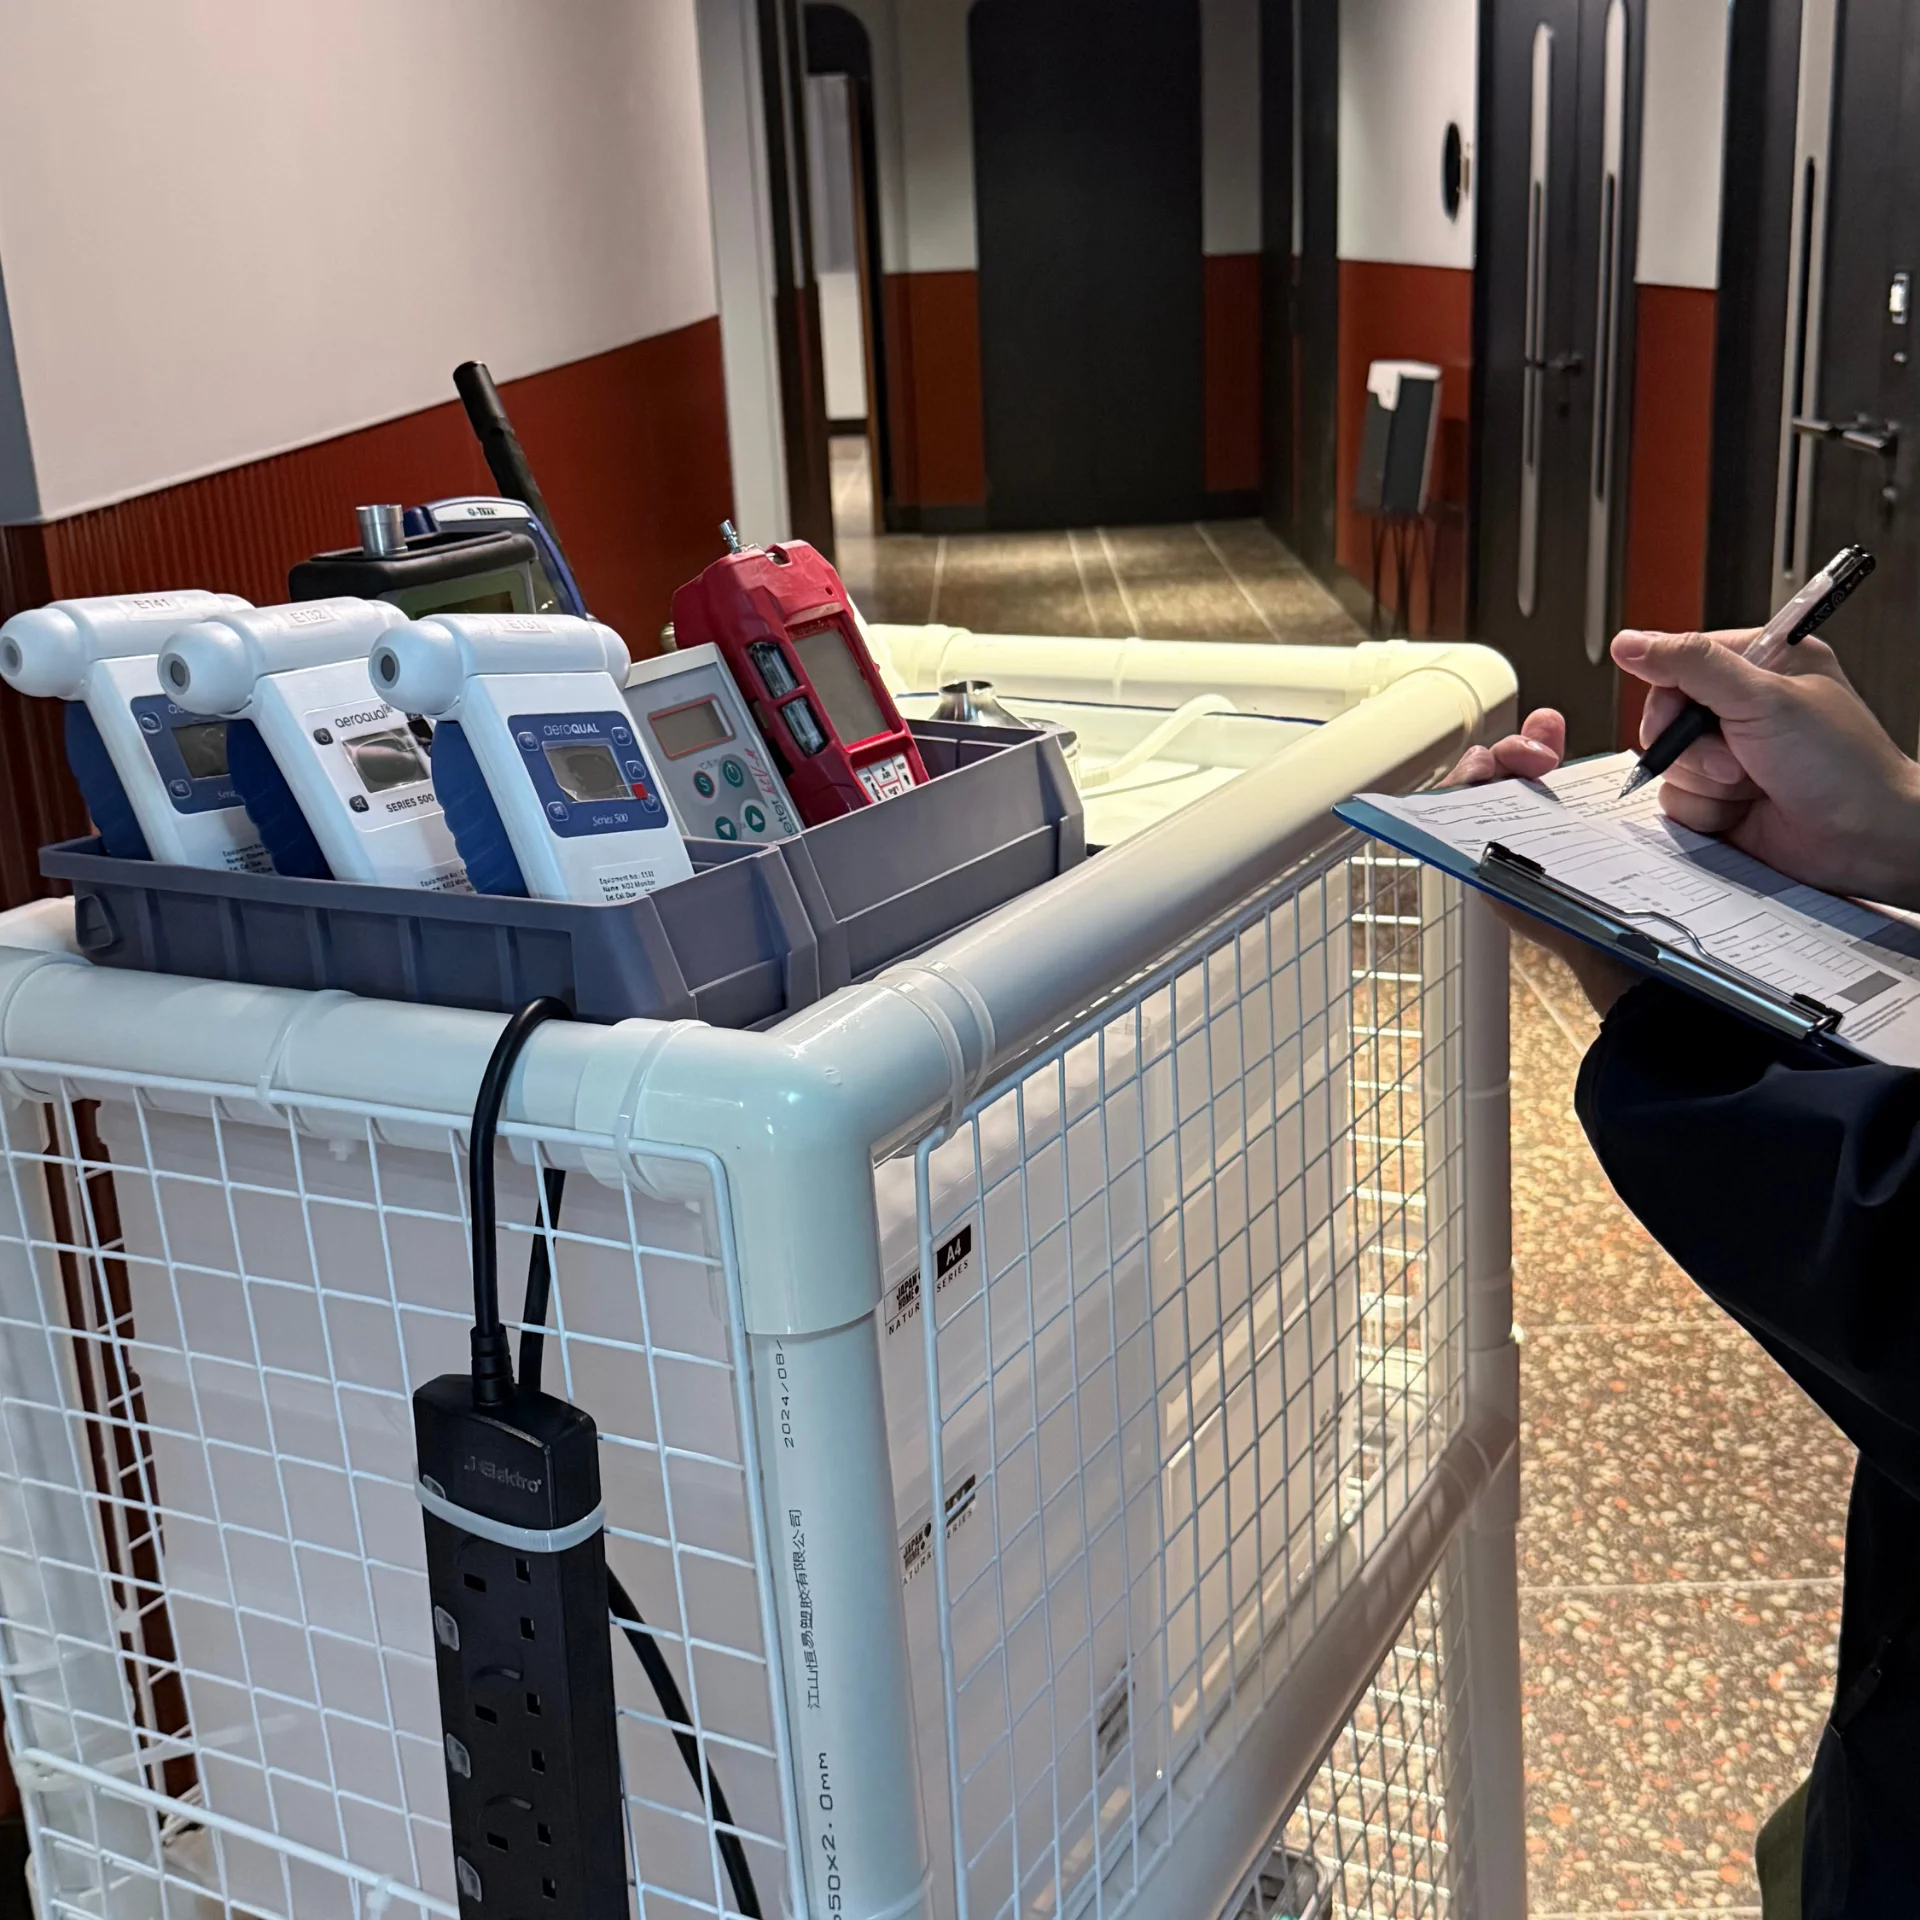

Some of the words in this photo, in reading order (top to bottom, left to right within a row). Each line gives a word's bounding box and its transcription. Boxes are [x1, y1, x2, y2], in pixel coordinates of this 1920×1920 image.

[133, 598, 172, 609] E141
[290, 609, 326, 623] E132
[543, 723, 600, 736] aeroQUAL
[386, 797, 417, 813] SERIES
[417, 793, 434, 805] 500
[614, 812, 629, 824] 500
[945, 1238, 962, 1267] A4
[896, 1274, 917, 1301] JAPAN
[888, 1302, 921, 1336] NATUR
[936, 1260, 969, 1293] SERIES
[946, 1507, 972, 1539] ERIES
